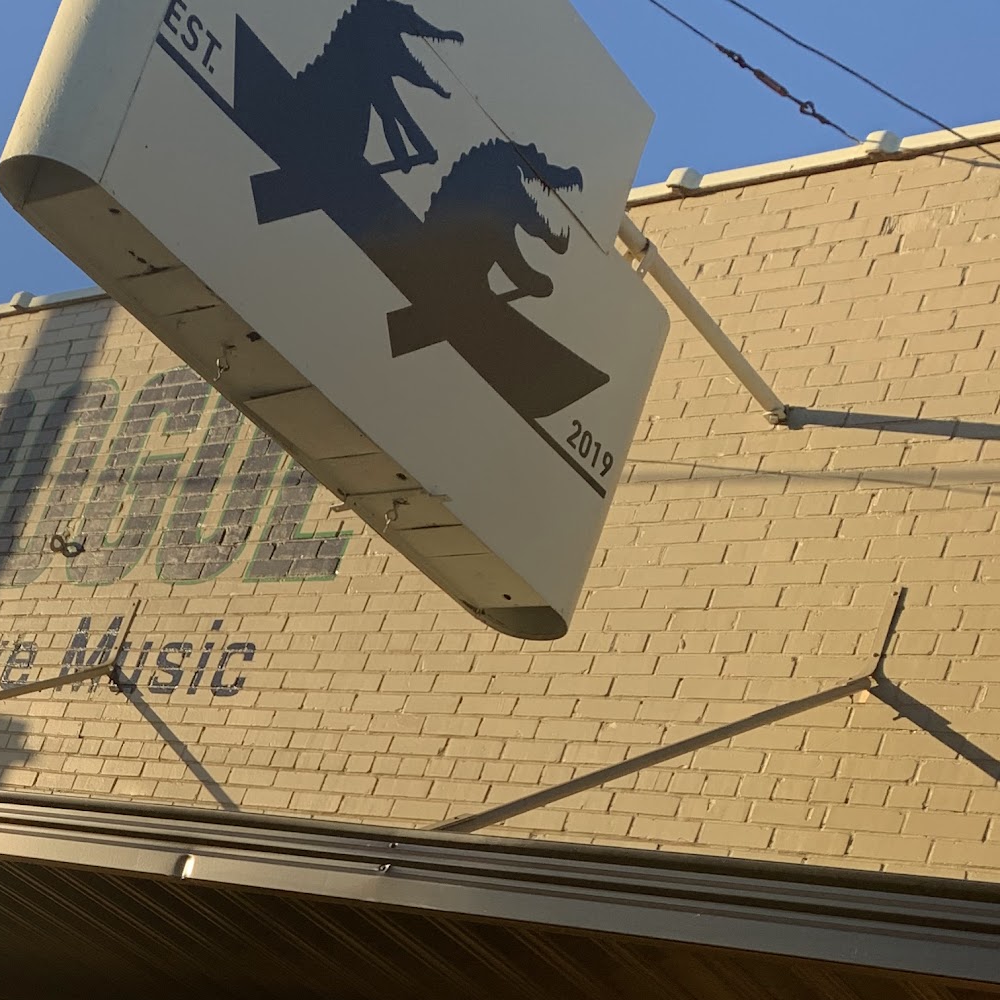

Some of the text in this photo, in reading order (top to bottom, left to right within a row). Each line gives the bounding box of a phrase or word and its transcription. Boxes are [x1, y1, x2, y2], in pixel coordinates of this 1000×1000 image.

[163, 0, 222, 74] EST.
[566, 419, 614, 477] 2019
[52, 615, 257, 697] Music
